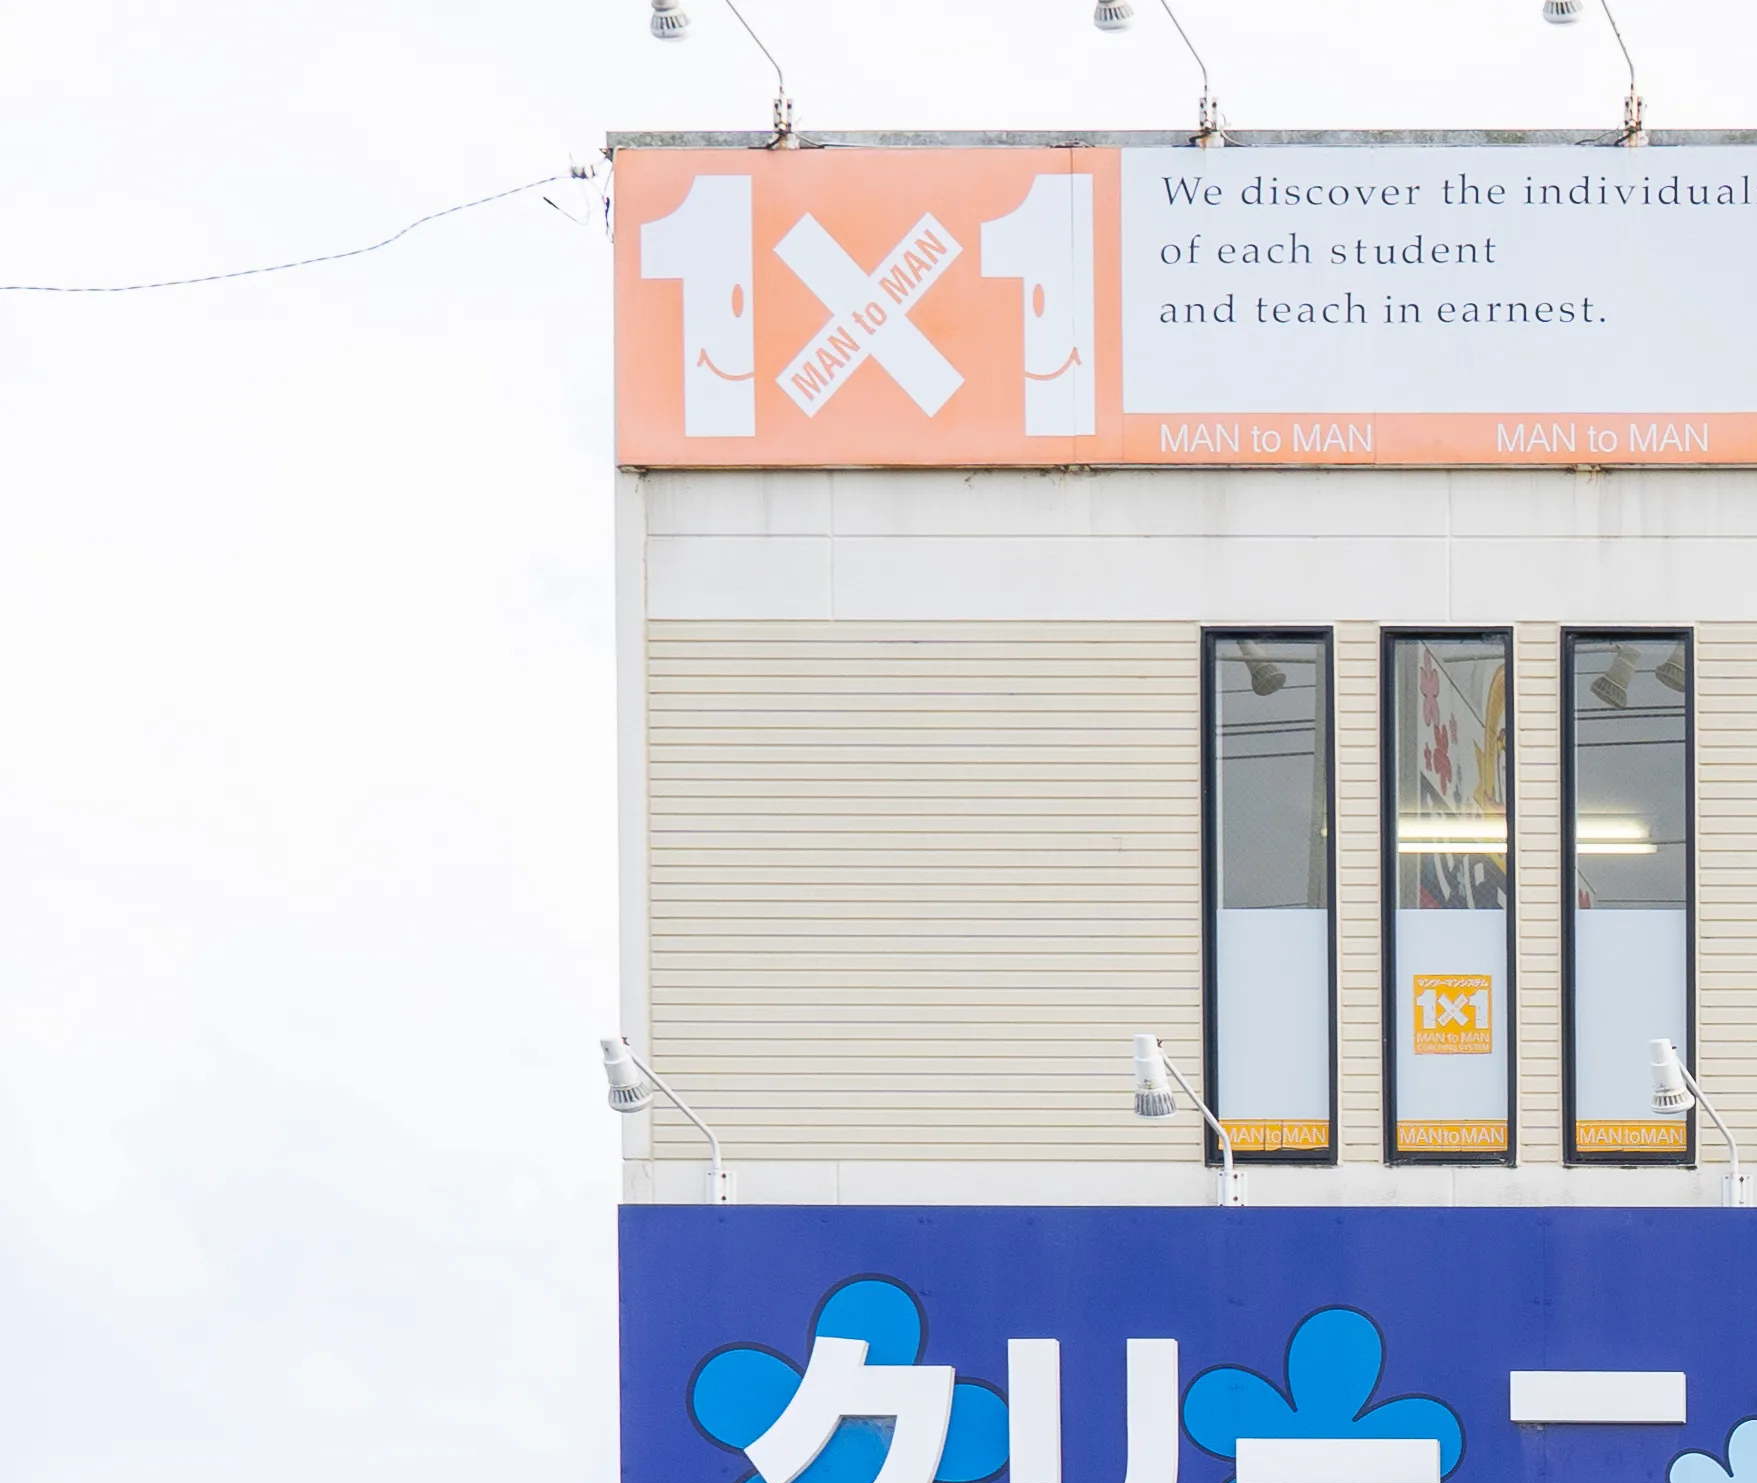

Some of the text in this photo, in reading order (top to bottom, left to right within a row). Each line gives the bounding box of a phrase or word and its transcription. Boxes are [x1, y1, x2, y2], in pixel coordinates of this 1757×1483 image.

[1162, 177, 1222, 205] We
[1242, 176, 1420, 205] discover
[1443, 173, 1505, 204] the
[1161, 233, 1495, 264] of each student
[790, 227, 947, 402] MAN to MAN
[1160, 292, 1605, 323] and teach in earnest.
[1161, 424, 1371, 452] MAN to MAN
[1498, 423, 1708, 452] MAN to MAN
[1417, 1033, 1445, 1043] MAN
[1461, 1033, 1488, 1043] MAN
[1400, 1127, 1504, 1145] MAN to MAN
